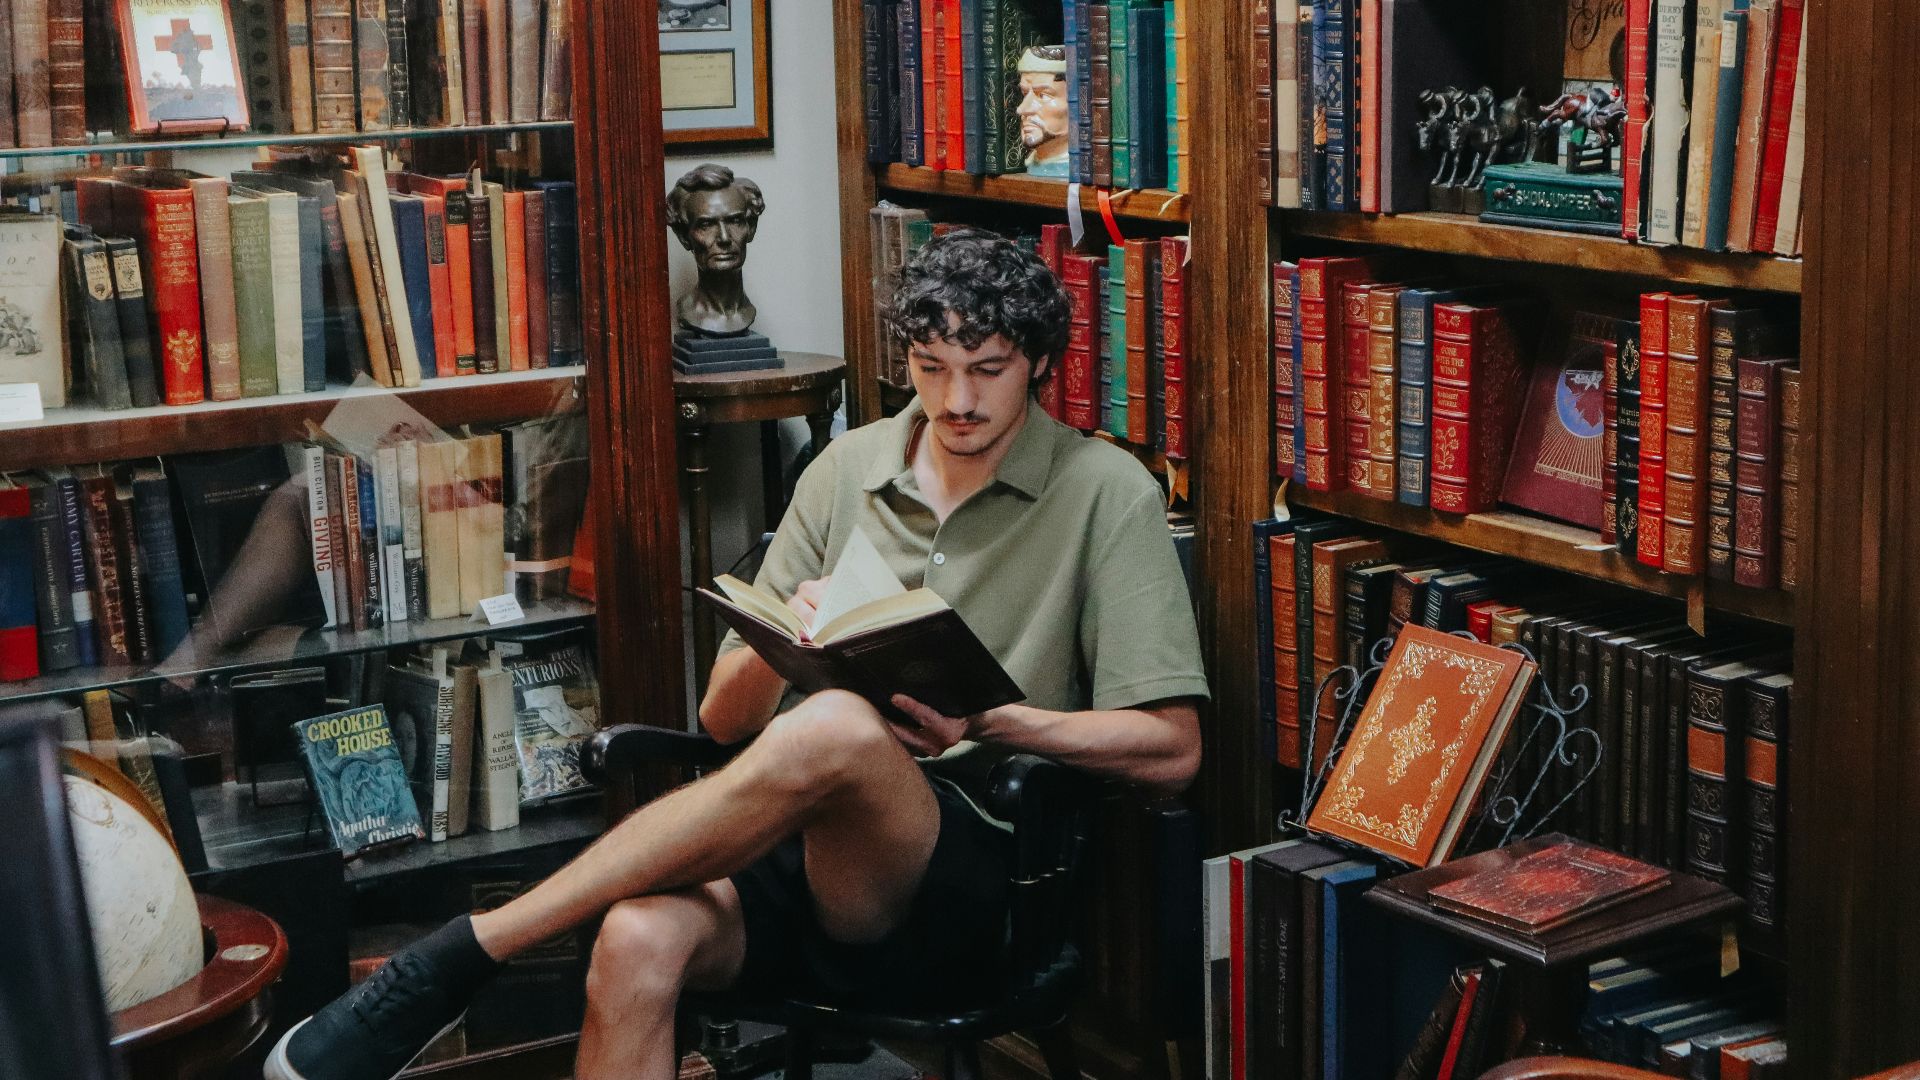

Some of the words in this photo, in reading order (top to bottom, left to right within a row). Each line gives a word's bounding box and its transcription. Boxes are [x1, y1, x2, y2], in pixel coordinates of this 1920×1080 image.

[63, 484, 80, 526] JIMMY
[315, 477, 324, 511] CLINTON
[68, 530, 86, 583] CARTER
[313, 517, 331, 573] GIVING
[369, 552, 379, 585] william
[369, 586, 379, 601] gay
[307, 709, 383, 743] CROOKED
[437, 686, 455, 736] SURFACING
[336, 728, 392, 757] HOUSE
[435, 743, 452, 781] ATWOOD
[338, 815, 387, 838] Agatha
[368, 823, 420, 845] Christie
